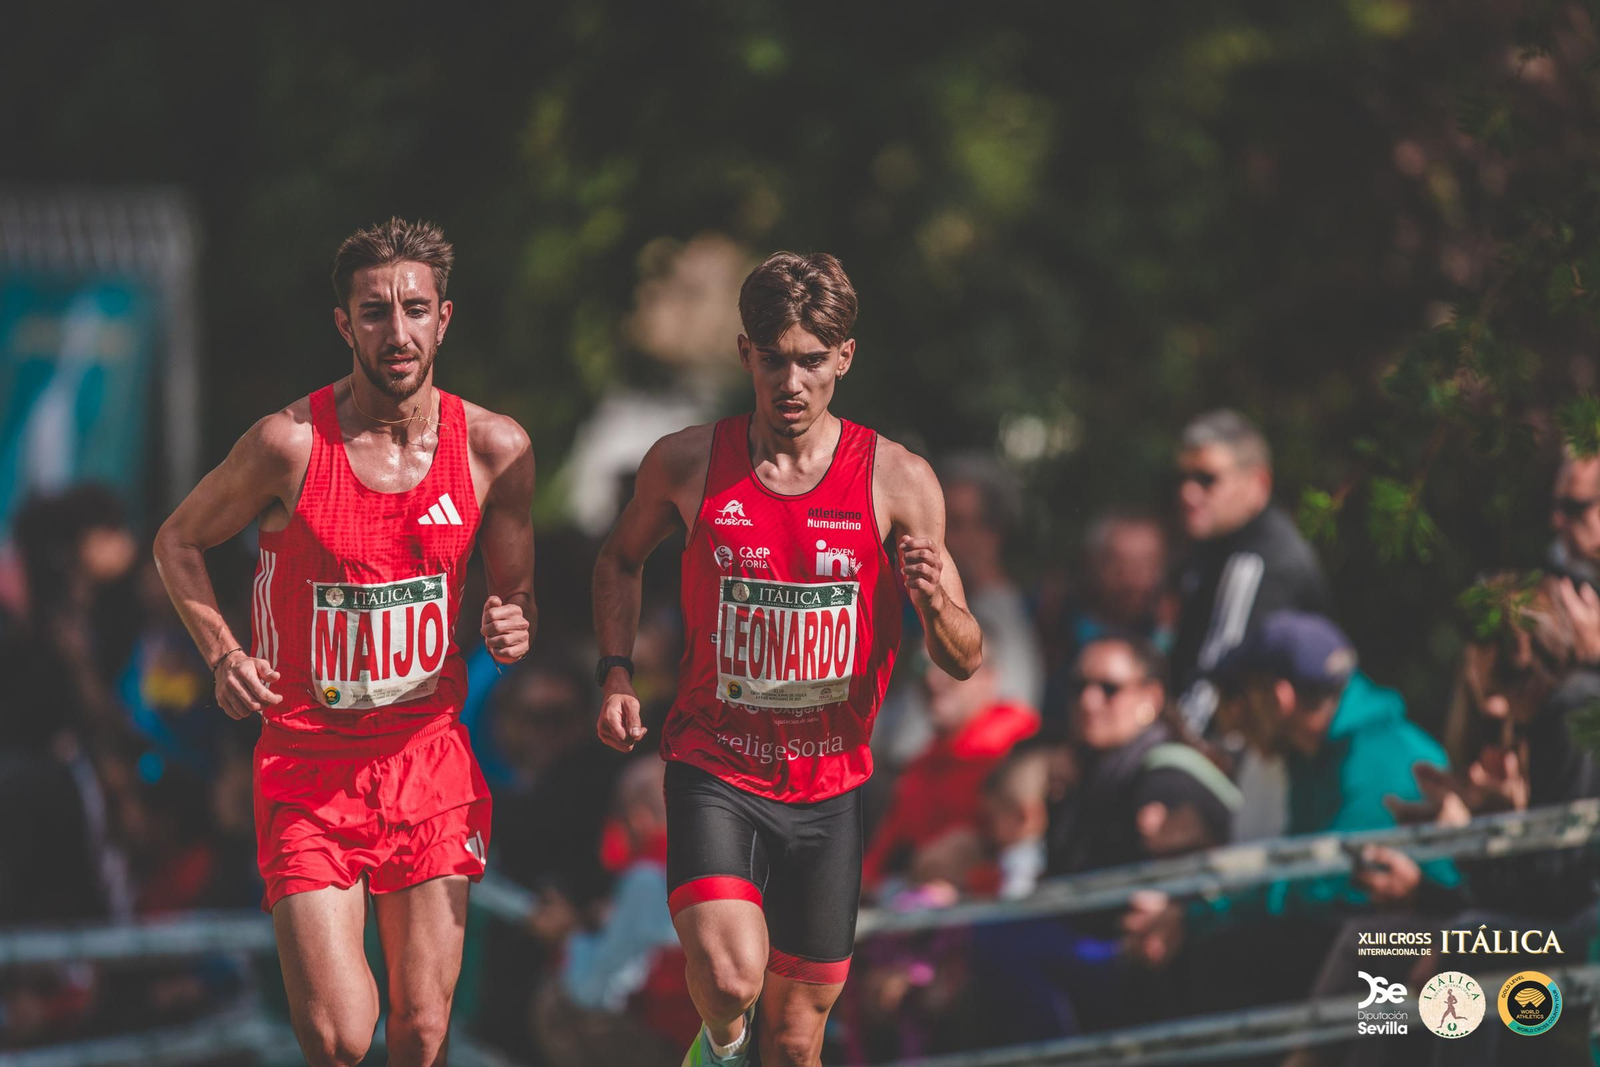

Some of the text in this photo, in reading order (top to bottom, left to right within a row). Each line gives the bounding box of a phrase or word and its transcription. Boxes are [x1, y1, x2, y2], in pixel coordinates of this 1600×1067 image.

[714, 516, 754, 526] austral
[808, 508, 862, 520] Atletismo
[808, 518, 861, 530] Numantino
[828, 548, 854, 556] JOVEN
[353, 588, 414, 605] ITÁLICA
[759, 587, 822, 604] ITÁLICA
[315, 602, 444, 682] MAIJO
[720, 604, 850, 681] LEONARDO
